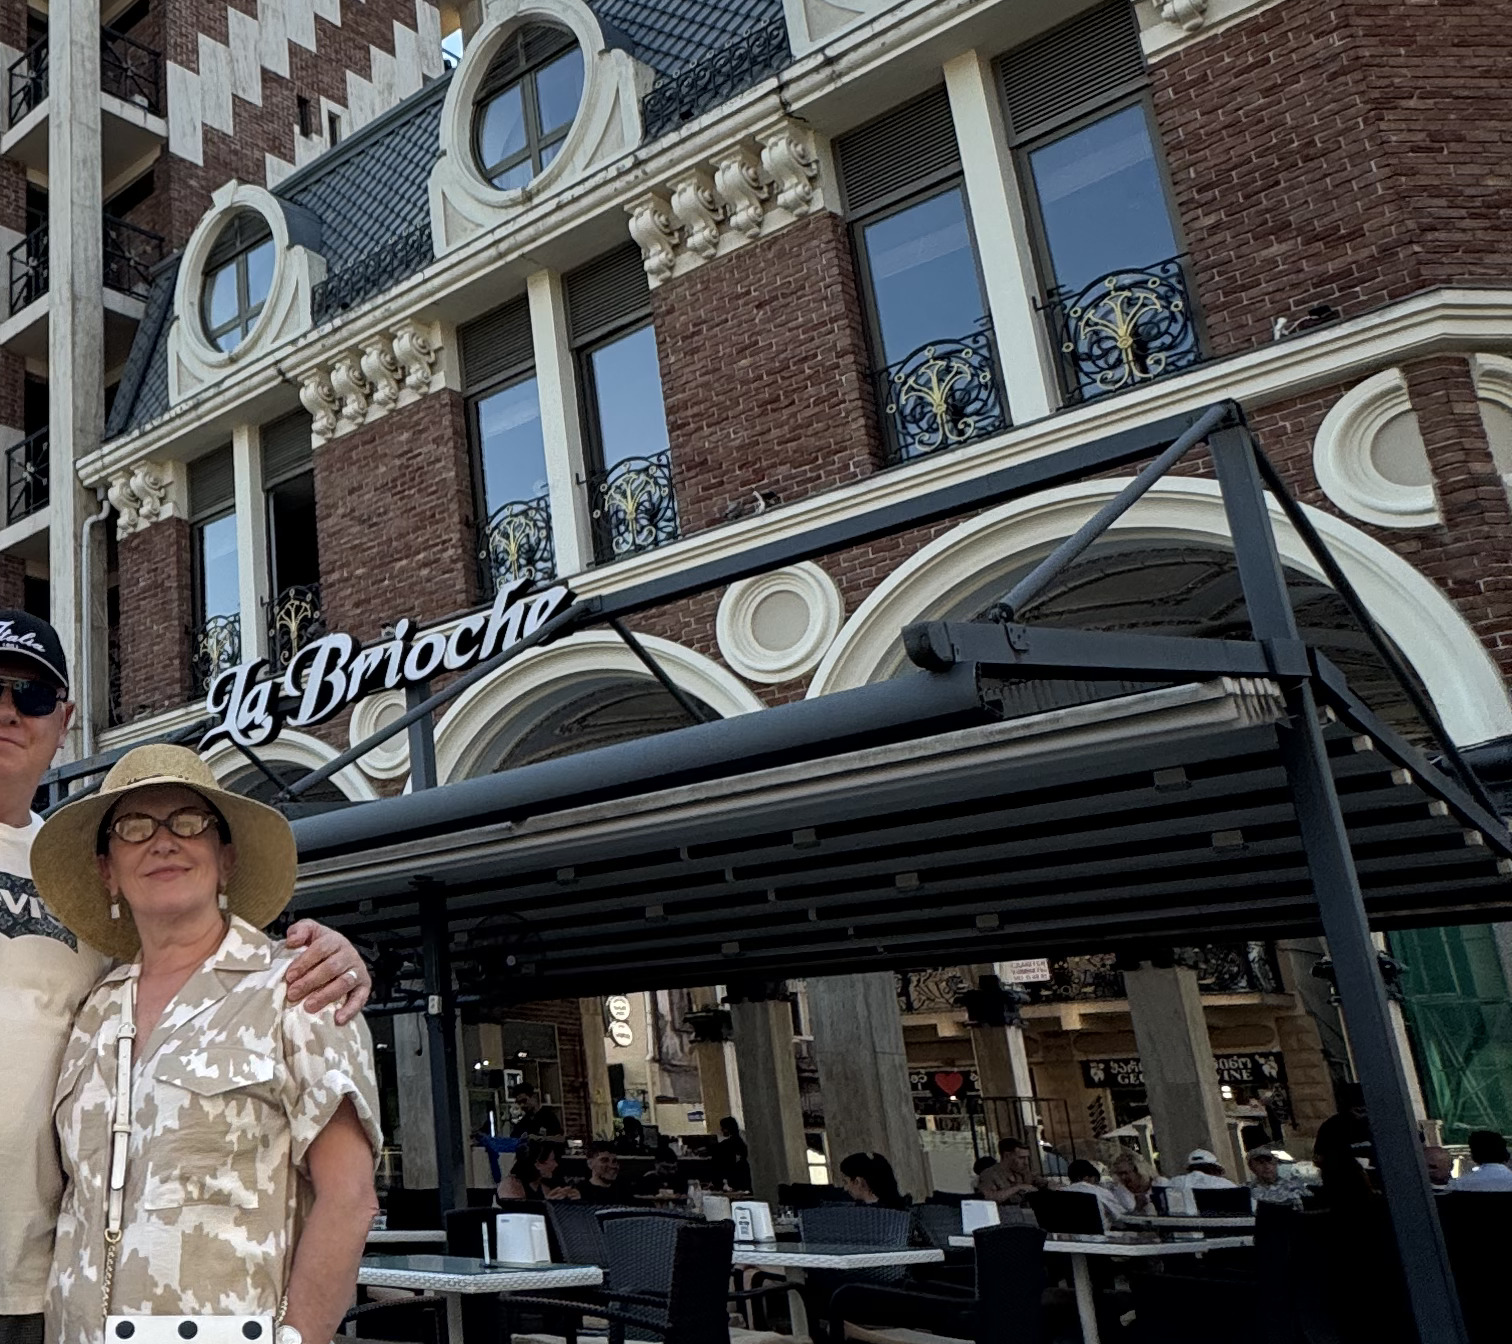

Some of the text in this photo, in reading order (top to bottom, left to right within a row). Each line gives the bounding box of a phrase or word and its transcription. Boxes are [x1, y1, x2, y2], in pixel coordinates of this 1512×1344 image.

[199, 579, 572, 747] La Brioche
[1217, 1068, 1255, 1081] INE
